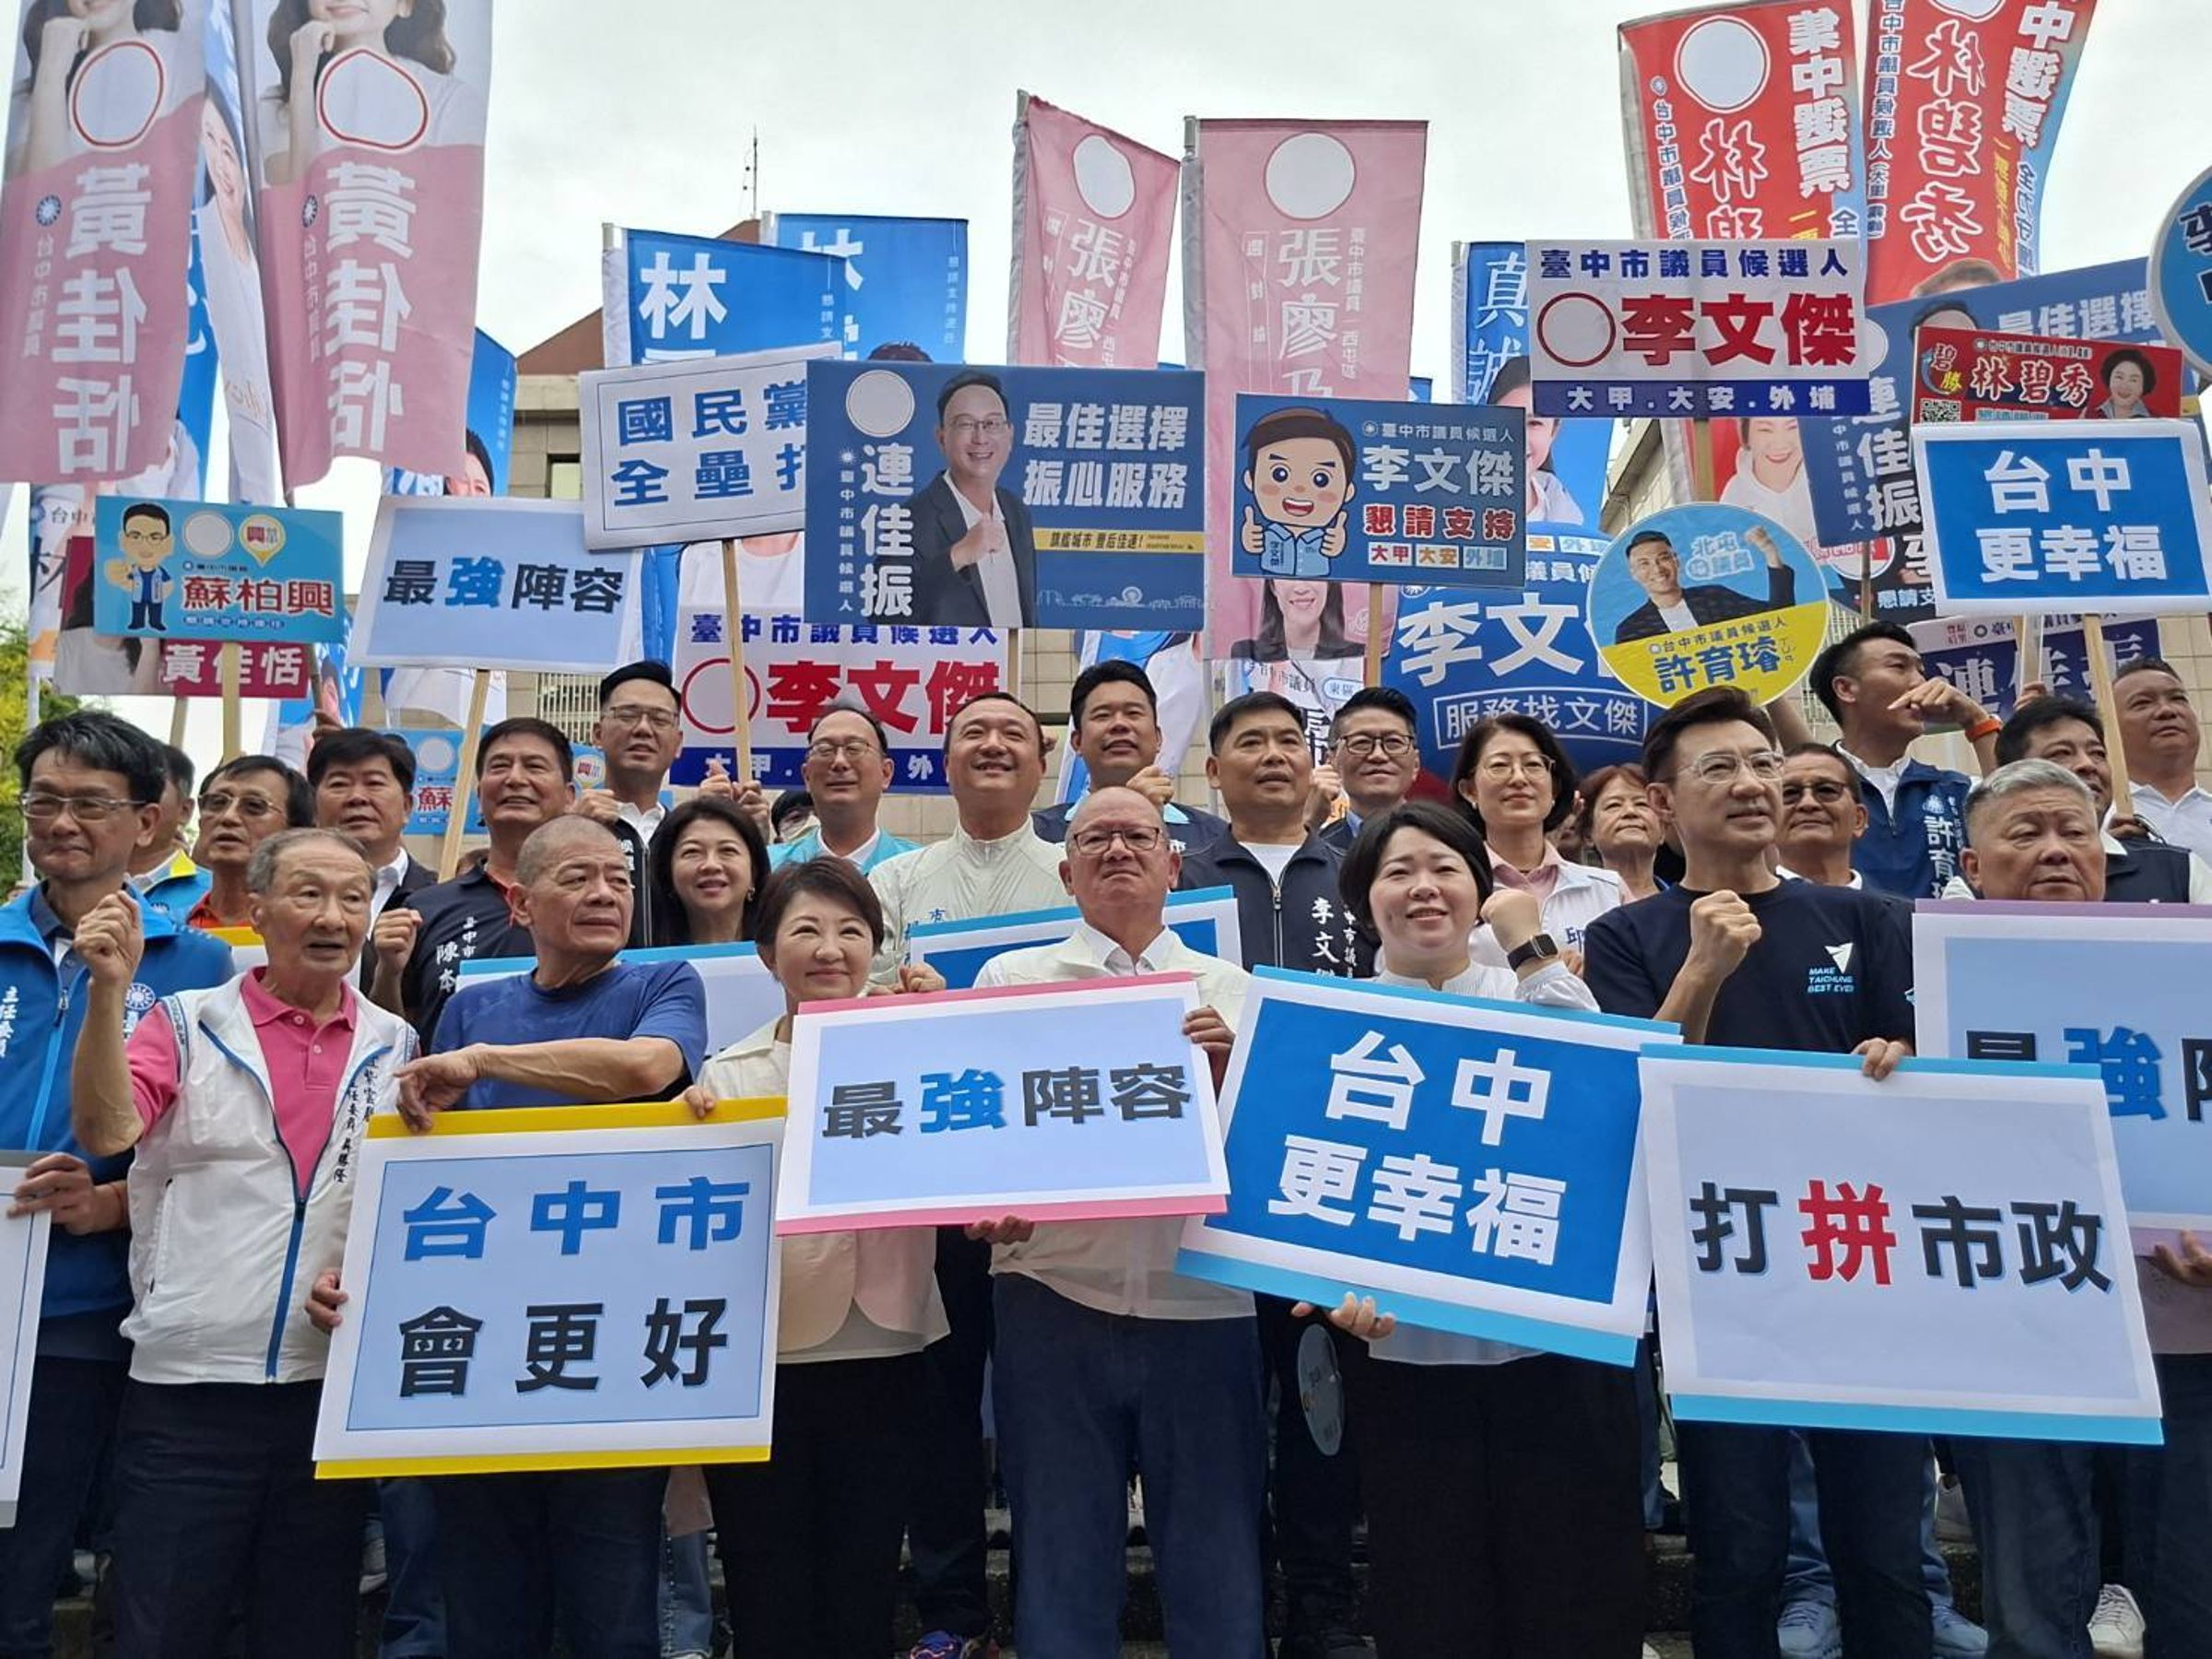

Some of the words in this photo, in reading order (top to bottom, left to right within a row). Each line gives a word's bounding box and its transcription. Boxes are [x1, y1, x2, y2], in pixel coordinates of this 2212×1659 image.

[639, 252, 727, 339] 林
[1054, 218, 1124, 367] 張廖
[1540, 248, 1848, 278] 臺中市議員候選人
[1620, 293, 1856, 367] 李文傑
[617, 379, 806, 447] 國民黨
[1970, 355, 2095, 408] 林碧秀
[1023, 402, 1190, 452] 最佳選擇
[1382, 422, 1514, 443] 臺中市議員候選人
[1021, 459, 1189, 510] 振心服務
[1362, 443, 1515, 497] 李文傑
[1831, 416, 1865, 532] 中市議員候選人
[1983, 448, 2132, 515] 台中
[860, 442, 915, 618] 連佳振
[1363, 503, 1516, 541] 懇請支持
[1371, 544, 1410, 563] 大甲
[1418, 546, 1457, 566] 大安
[1974, 524, 2170, 585] 更幸福
[183, 576, 334, 616] 蘇柏興
[382, 555, 624, 614] 最強陣容
[163, 644, 302, 686] 黃佳恬
[1398, 592, 1611, 688] 李文
[766, 660, 1000, 735] 李文傑
[1311, 896, 1340, 977] 李文
[1806, 983, 1831, 993] BEST
[1808, 966, 1837, 975] MAKE
[824, 1063, 1191, 1138] 最強陣容
[1324, 1030, 1551, 1147] 台中
[402, 1176, 751, 1262] 台中市
[1267, 1134, 1567, 1266] 更幸福
[1688, 1179, 2114, 1295] 打拼市政
[398, 1297, 729, 1399] 會更好
